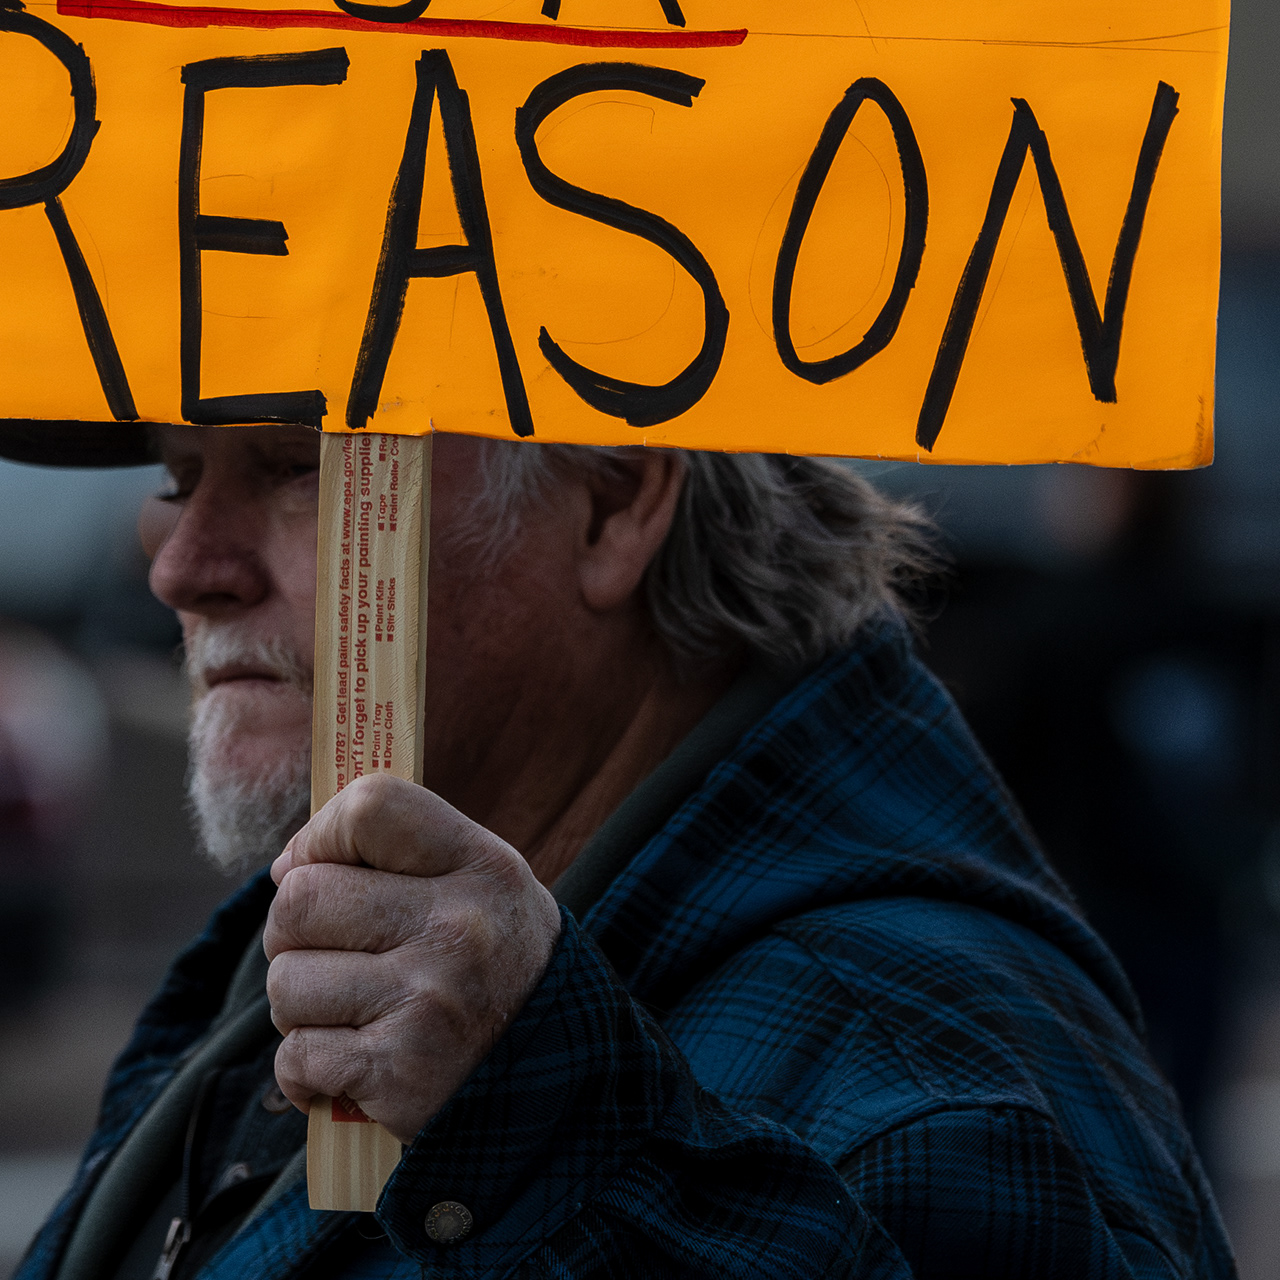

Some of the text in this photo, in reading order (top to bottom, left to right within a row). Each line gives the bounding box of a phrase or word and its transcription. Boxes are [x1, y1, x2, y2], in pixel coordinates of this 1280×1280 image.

[390, 459, 399, 491] Roller
[378, 494, 388, 520] Tape
[389, 493, 398, 522] Paint
[341, 542, 351, 555] at
[357, 501, 373, 568] painting
[339, 558, 350, 590] facts
[358, 571, 370, 609] your
[339, 594, 351, 632] safety
[375, 579, 385, 632] Paint Kits
[387, 577, 395, 632] Stir Sticks
[357, 613, 370, 634] up
[338, 636, 349, 668] paint
[354, 638, 369, 672] pick
[337, 671, 347, 698] lead
[354, 677, 366, 693] to
[337, 702, 347, 724] Get
[353, 697, 368, 746] forget
[372, 703, 383, 758] Paint Tray
[384, 701, 394, 758] Drop Cloth
[335, 732, 346, 769] 1978?
[334, 773, 345, 795] ore
